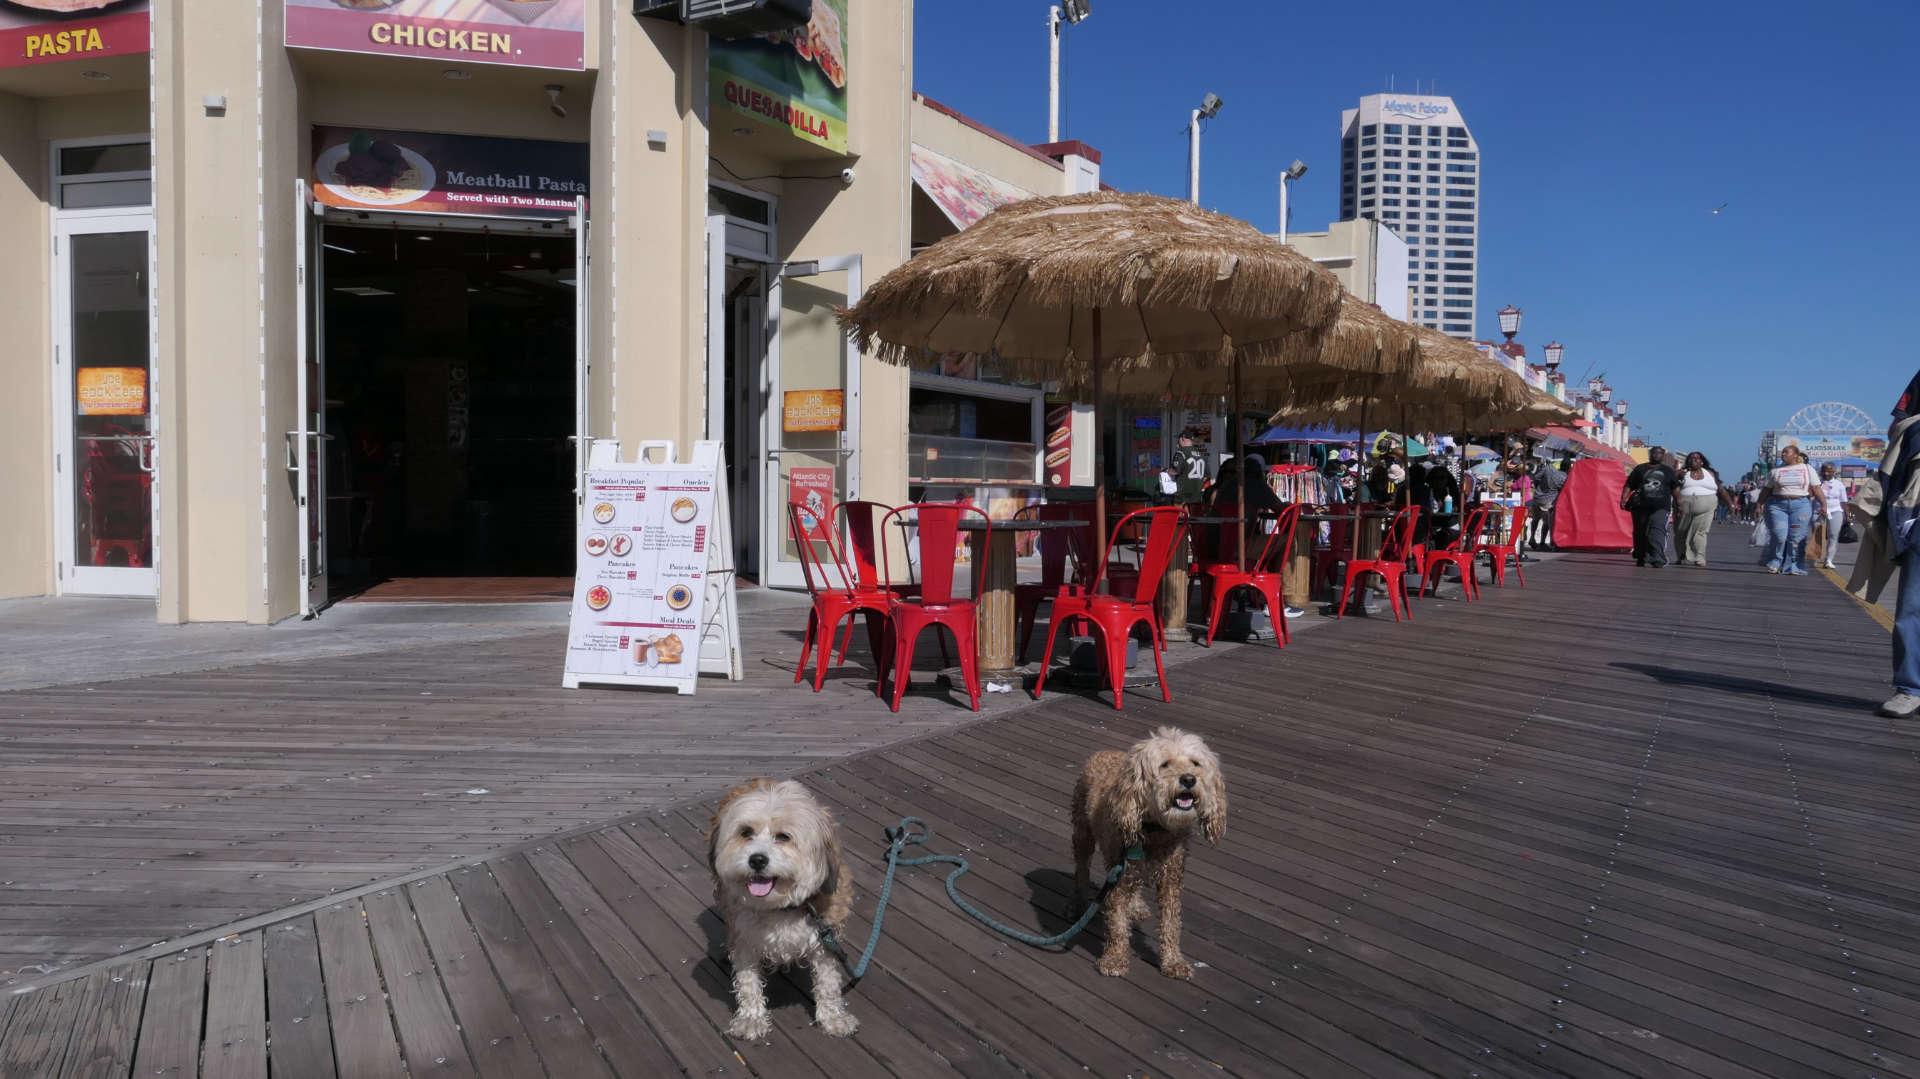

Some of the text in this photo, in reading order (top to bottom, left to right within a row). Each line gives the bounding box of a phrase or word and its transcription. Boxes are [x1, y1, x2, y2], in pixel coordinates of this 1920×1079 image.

[26, 28, 104, 58] PASTA
[370, 22, 511, 54] CHICKEN
[724, 80, 829, 140] QUESADILLA
[1383, 100, 1449, 114] Atlantic Palace
[446, 171, 586, 193] Meatball Pasta
[446, 192, 482, 202] Served
[485, 193, 509, 204] with
[511, 195, 533, 206] Two
[1187, 457, 1206, 479] 20
[621, 478, 646, 487] Popular
[817, 473, 831, 481] City
[669, 563, 699, 571] Pancakes
[660, 616, 676, 624] Meal
